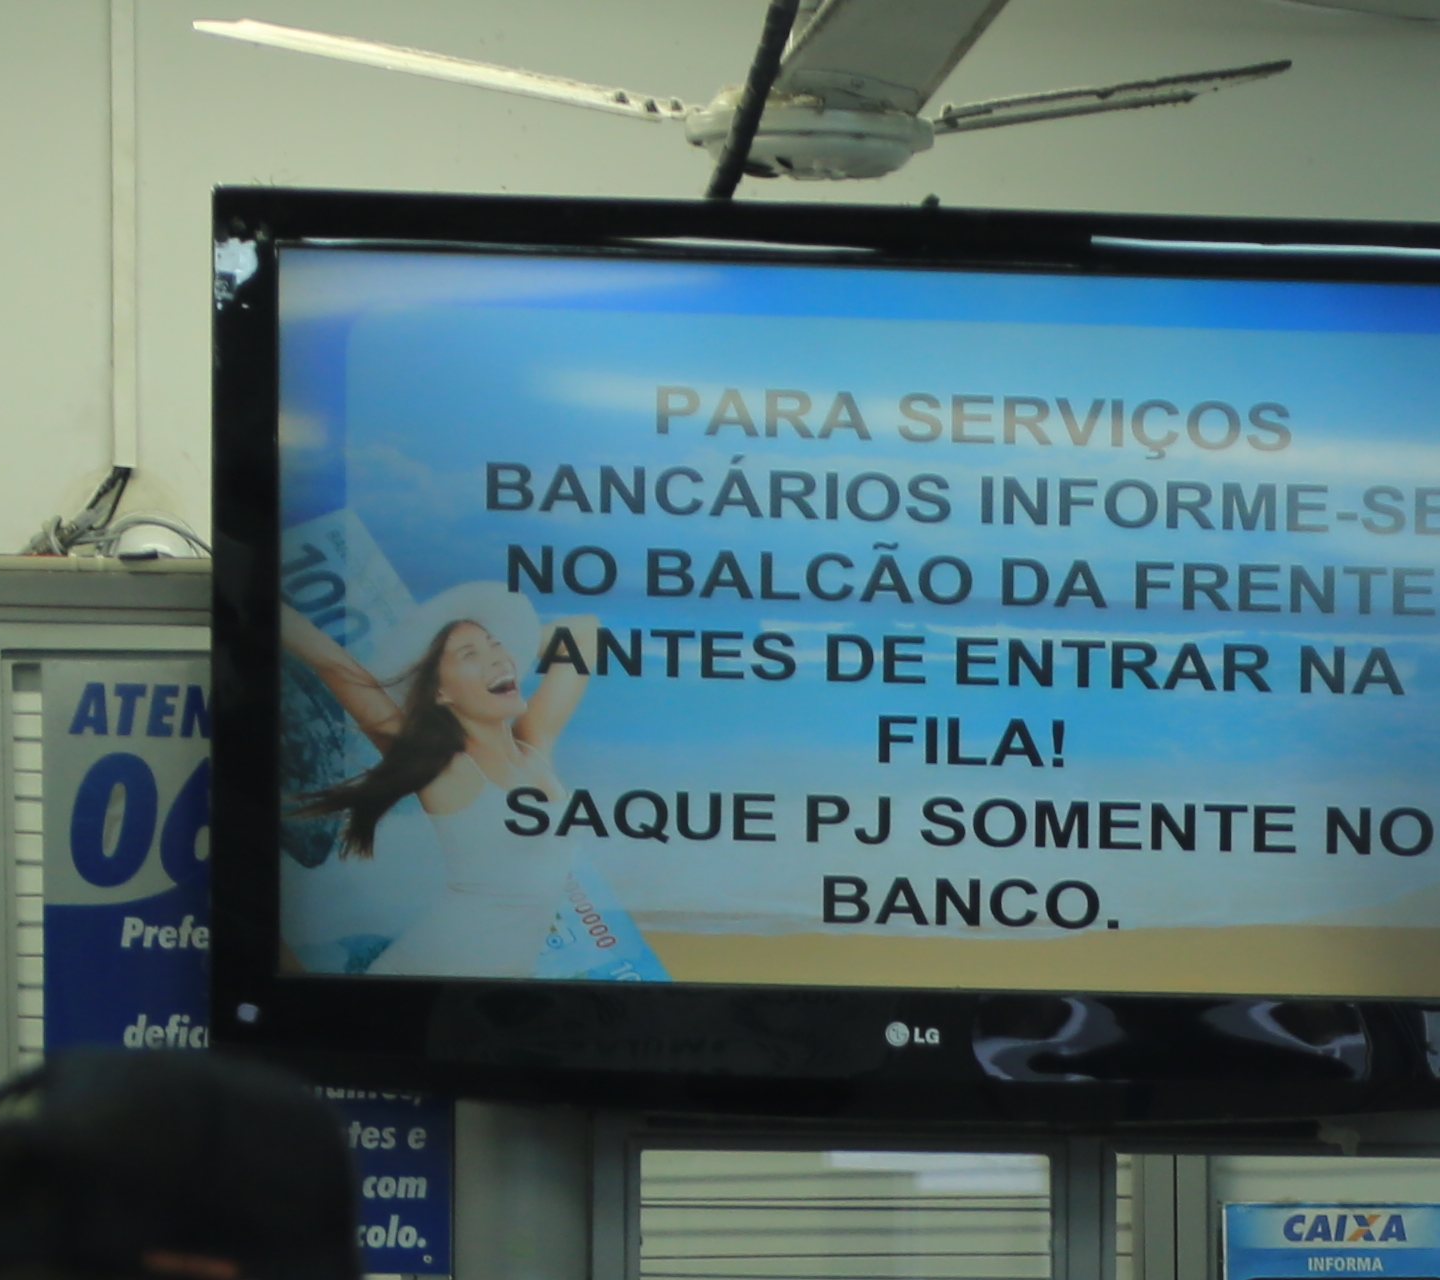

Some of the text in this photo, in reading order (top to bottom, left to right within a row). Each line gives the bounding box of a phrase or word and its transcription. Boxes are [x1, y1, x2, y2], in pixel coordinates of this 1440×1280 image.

[654, 385, 1293, 461] PARA SERVIÇOS
[483, 456, 953, 524] BANCÁRIOS
[507, 538, 1437, 618] NO BALCÃO DA FRENTE
[535, 626, 1406, 698] ANTES DE ENTRAR NA
[876, 714, 1067, 768] FILA!
[502, 786, 1436, 859] SAQUE PJ SOMENTE NO
[821, 875, 1121, 932] BANCO.
[913, 1026, 940, 1044] LG
[349, 1120, 427, 1149] tes e
[363, 1176, 427, 1199] com
[1282, 1213, 1407, 1242] CAIXA
[1307, 1257, 1384, 1273] INFORMA
